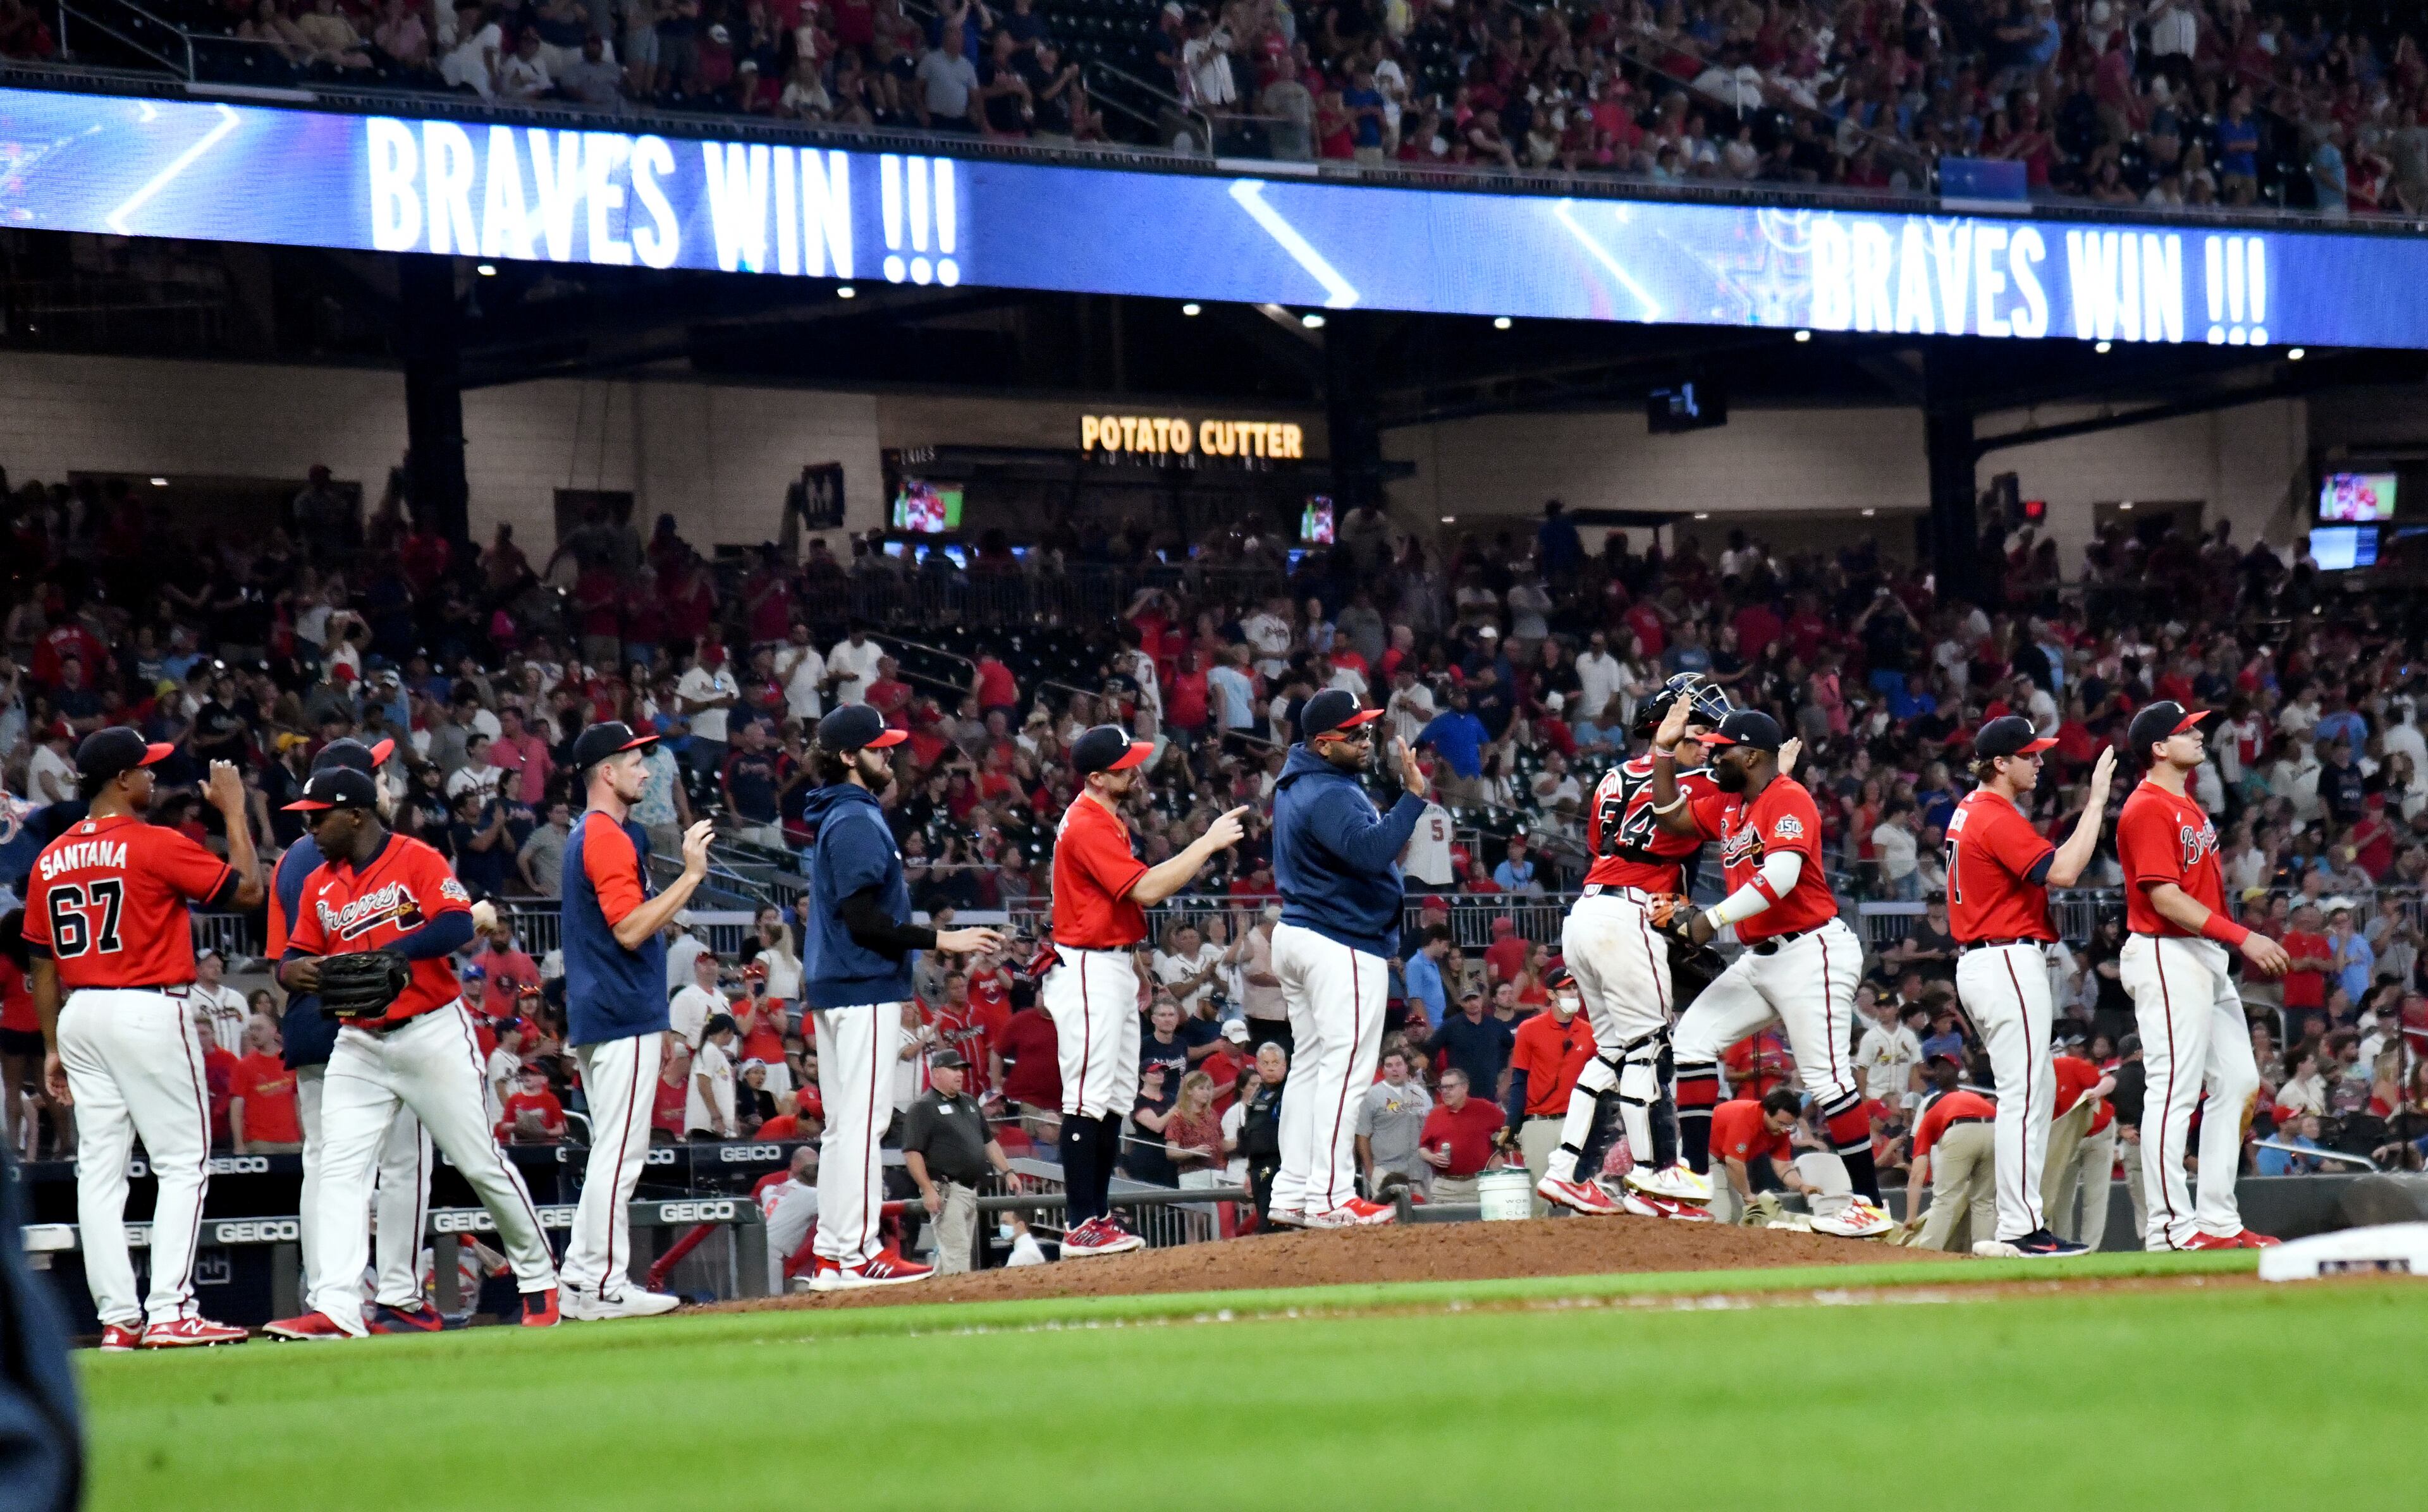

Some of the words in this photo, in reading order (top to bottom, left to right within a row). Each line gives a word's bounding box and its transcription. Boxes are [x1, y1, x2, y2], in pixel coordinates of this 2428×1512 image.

[366, 116, 680, 269] BRAVES
[702, 140, 854, 278] WIN
[880, 153, 960, 286] !!!
[1810, 218, 2049, 339] BRAVES
[2066, 229, 2183, 343] WIN
[2204, 235, 2269, 346] !!!
[1081, 415, 1191, 454] POTATO
[1199, 420, 1303, 458] CUTTER
[1430, 819, 1444, 842] 5
[1777, 822, 1798, 835] 150
[39, 840, 128, 881] SANTANA
[46, 877, 125, 960] 67
[720, 1145, 782, 1162] GEICO
[434, 1212, 496, 1233] GEIC
[660, 1201, 735, 1222] GEICO
[216, 1221, 299, 1243] GEICO
